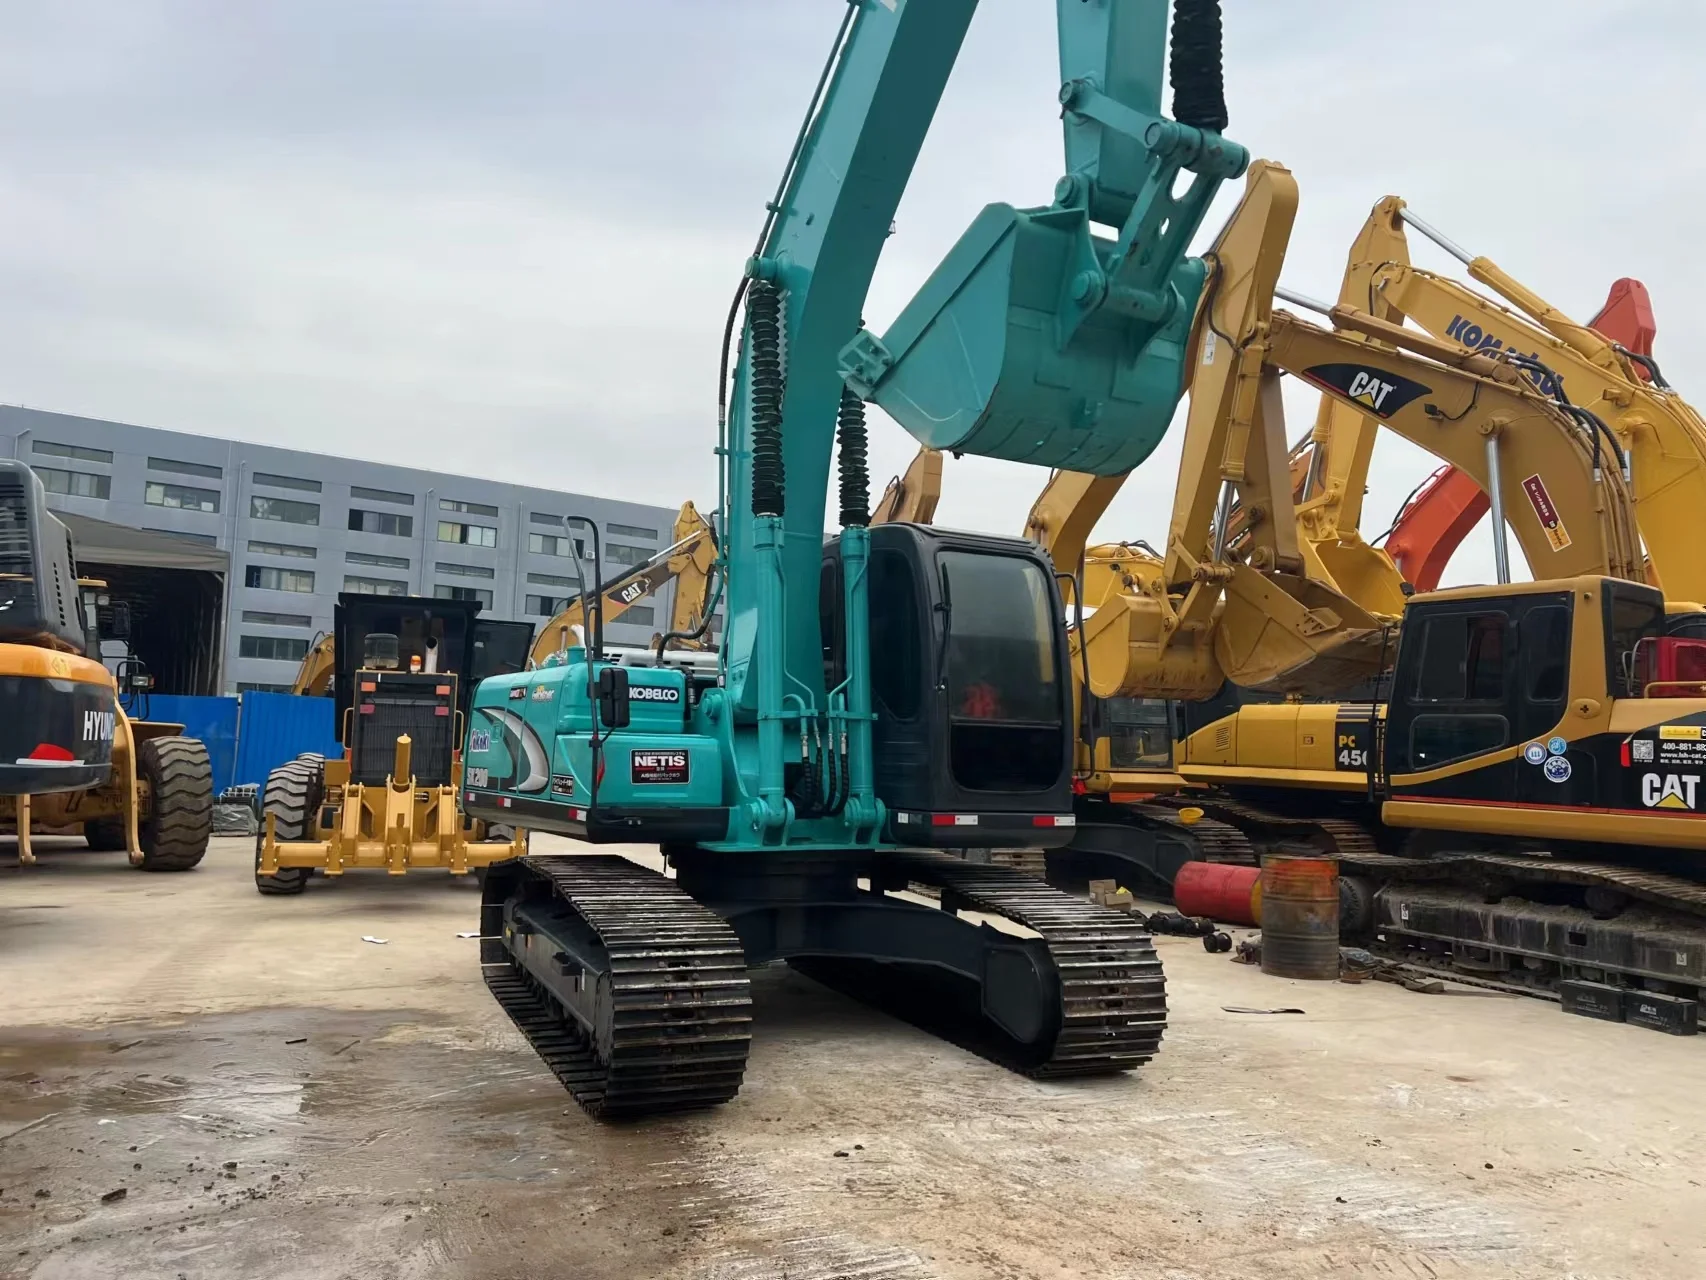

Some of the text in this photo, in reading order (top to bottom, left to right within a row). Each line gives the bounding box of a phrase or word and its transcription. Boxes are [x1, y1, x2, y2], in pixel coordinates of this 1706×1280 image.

[1349, 371, 1394, 410] CAT
[621, 582, 642, 602] CAT
[629, 687, 678, 701] KOBELCO
[1339, 735, 1355, 748] PC
[635, 755, 685, 767] NETIS
[1642, 772, 1701, 810] CAT
